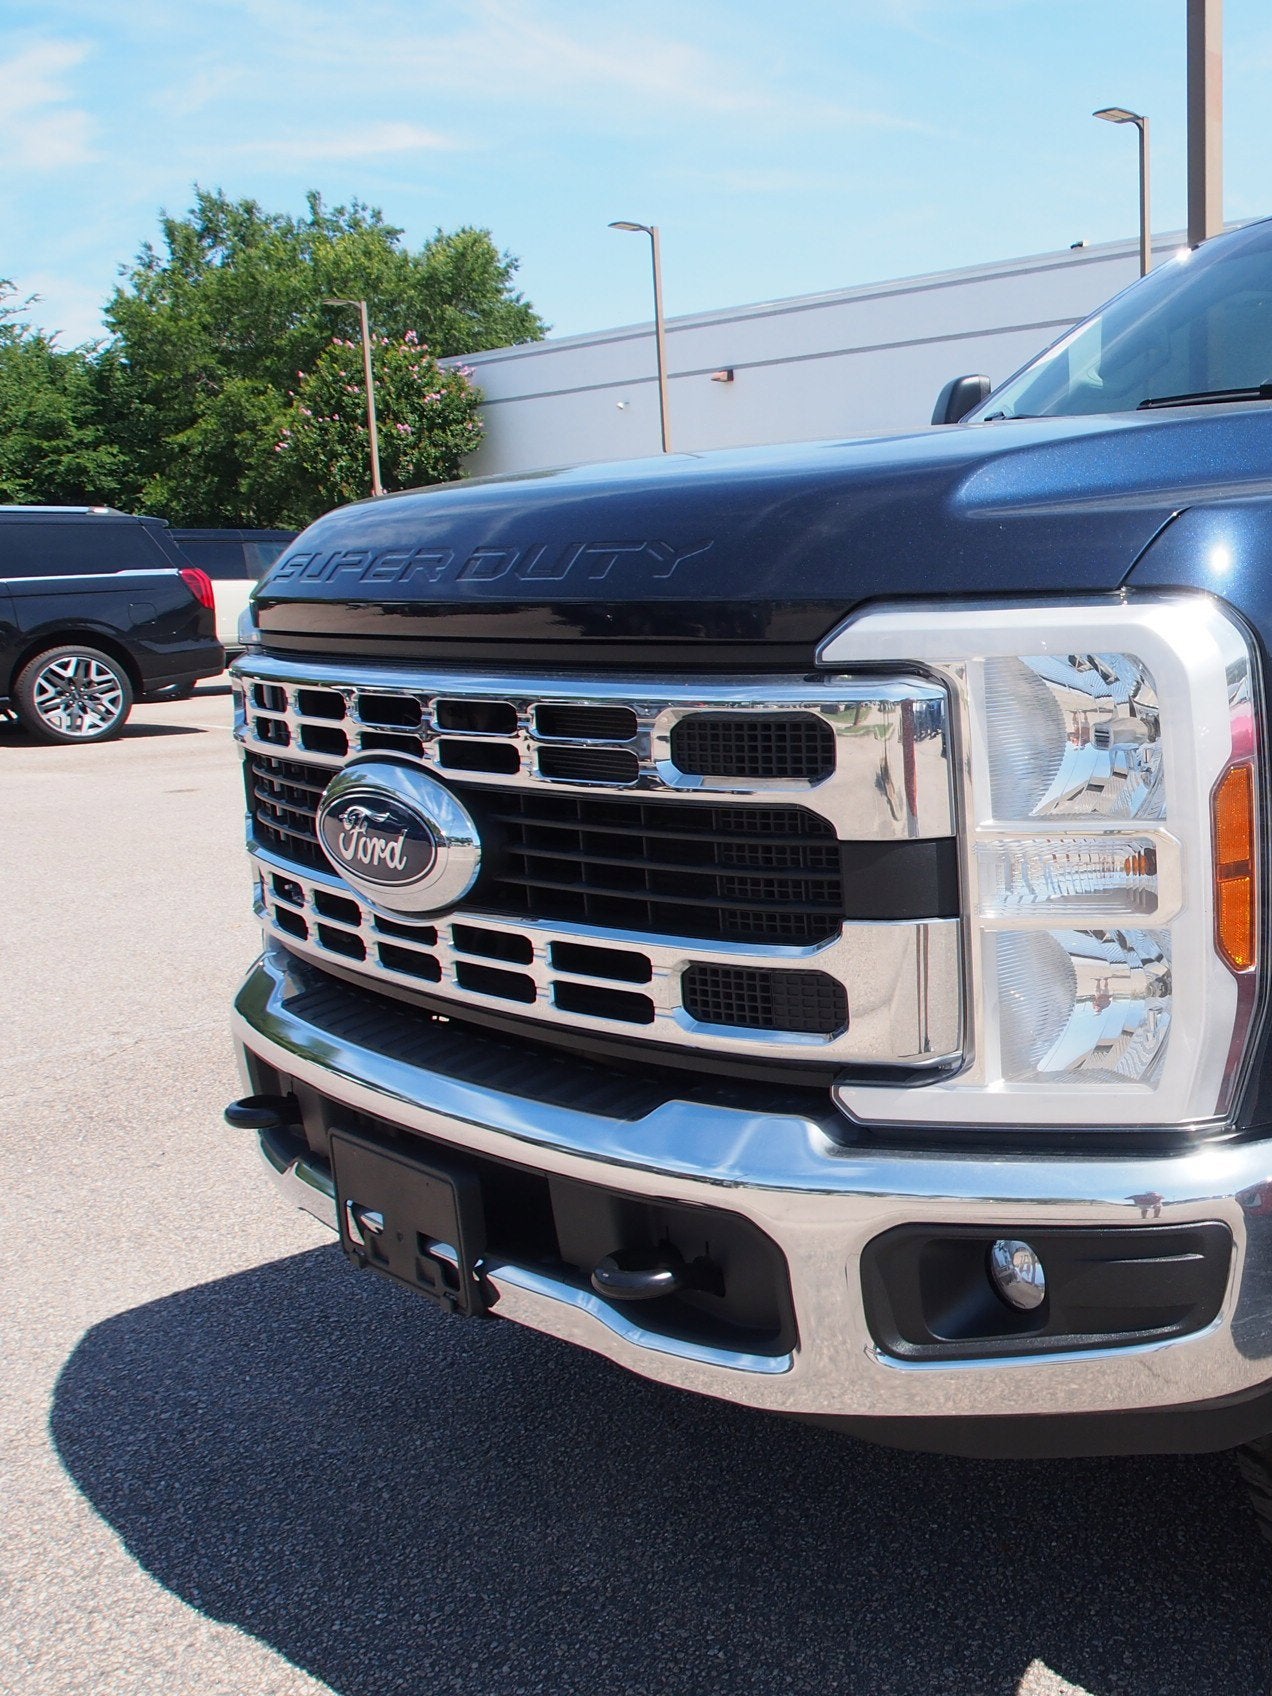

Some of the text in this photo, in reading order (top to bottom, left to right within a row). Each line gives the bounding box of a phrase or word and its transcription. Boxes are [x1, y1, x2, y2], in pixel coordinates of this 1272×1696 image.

[272, 540, 715, 583] SUPER DUTY
[338, 805, 410, 871] Ford
